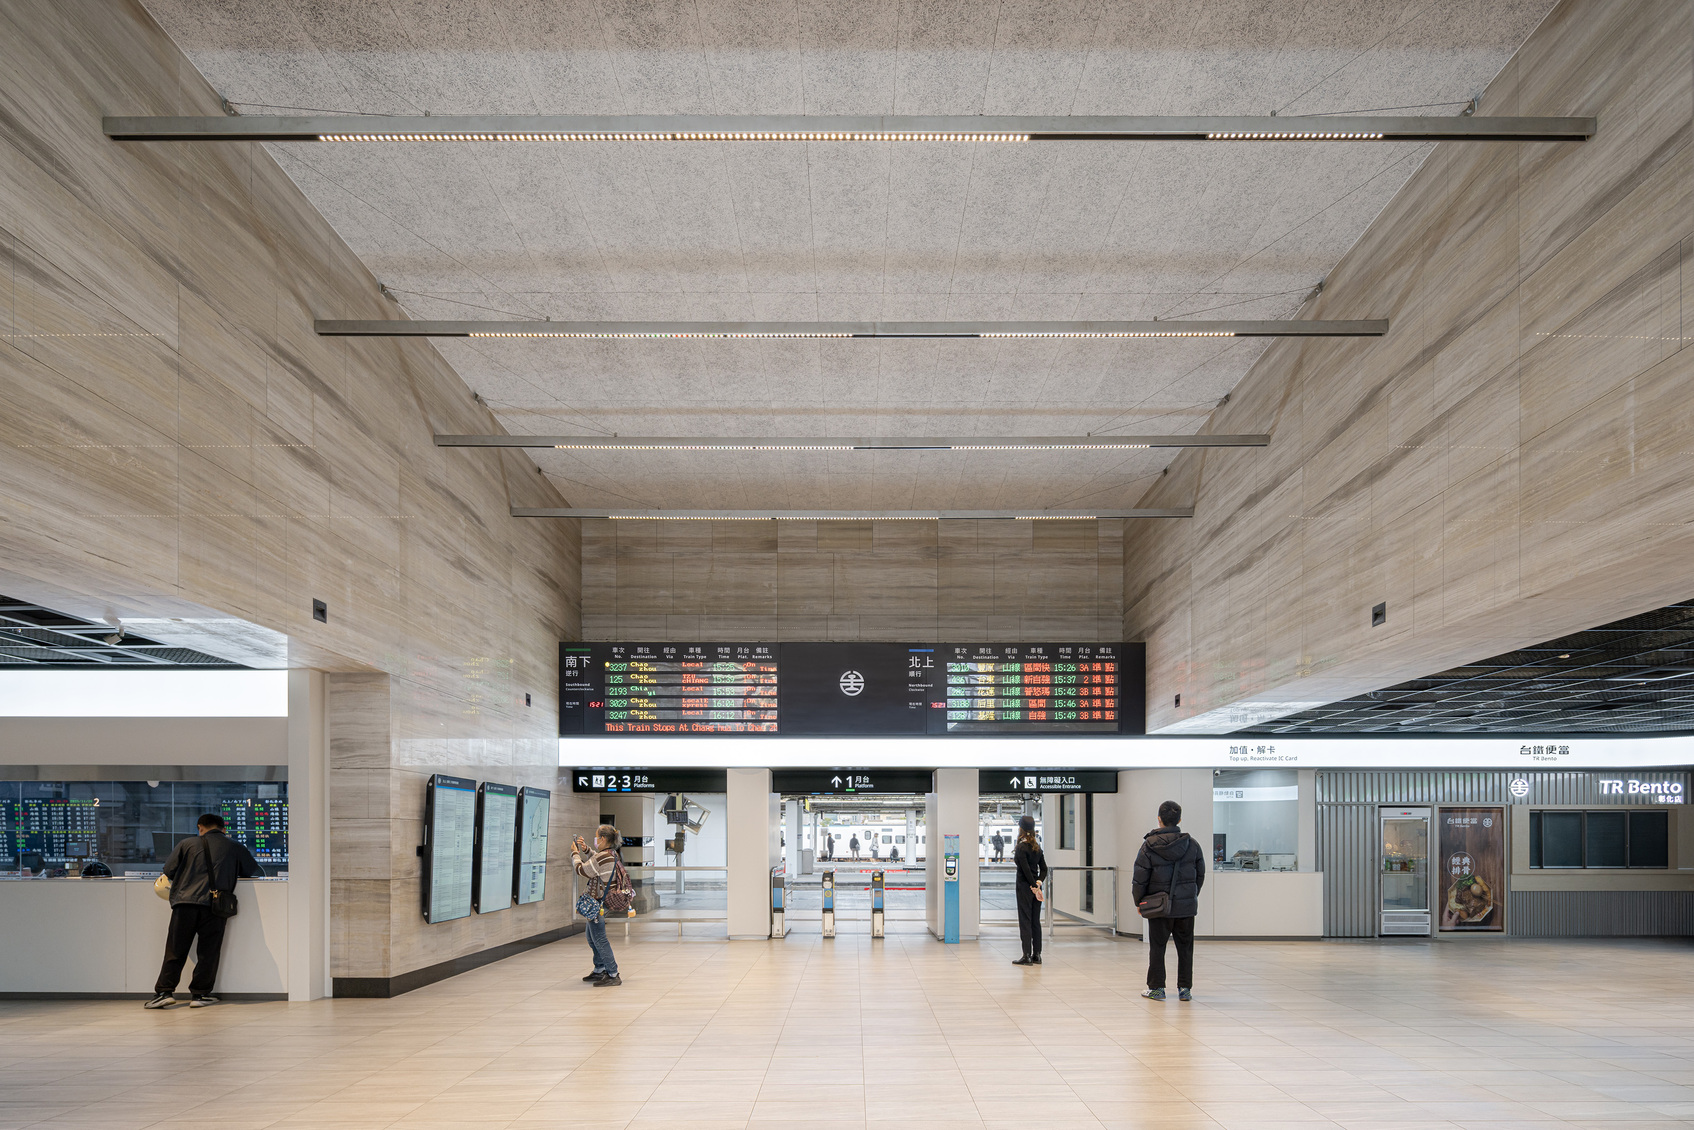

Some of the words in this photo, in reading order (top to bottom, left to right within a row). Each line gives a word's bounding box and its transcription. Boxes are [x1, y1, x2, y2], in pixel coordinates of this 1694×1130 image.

[566, 656, 591, 668] 南下
[909, 656, 934, 668] 北上
[606, 723, 624, 731] This
[627, 723, 650, 731] Train
[653, 723, 675, 731] Stops
[679, 723, 688, 731] At
[692, 723, 714, 731] Chang
[718, 723, 732, 731] hua
[736, 723, 745, 731] To
[748, 723, 766, 731] Chao
[1520, 745, 1570, 755] 台鐵便當
[846, 776, 852, 788] 1
[1600, 780, 1623, 794] TR
[1628, 780, 1682, 794] Bento
[93, 798, 100, 807] 2
[247, 798, 251, 807] 1
[1658, 795, 1682, 803] 彰化店
[1452, 856, 1471, 865] 經典
[1452, 866, 1471, 875] 排骨
